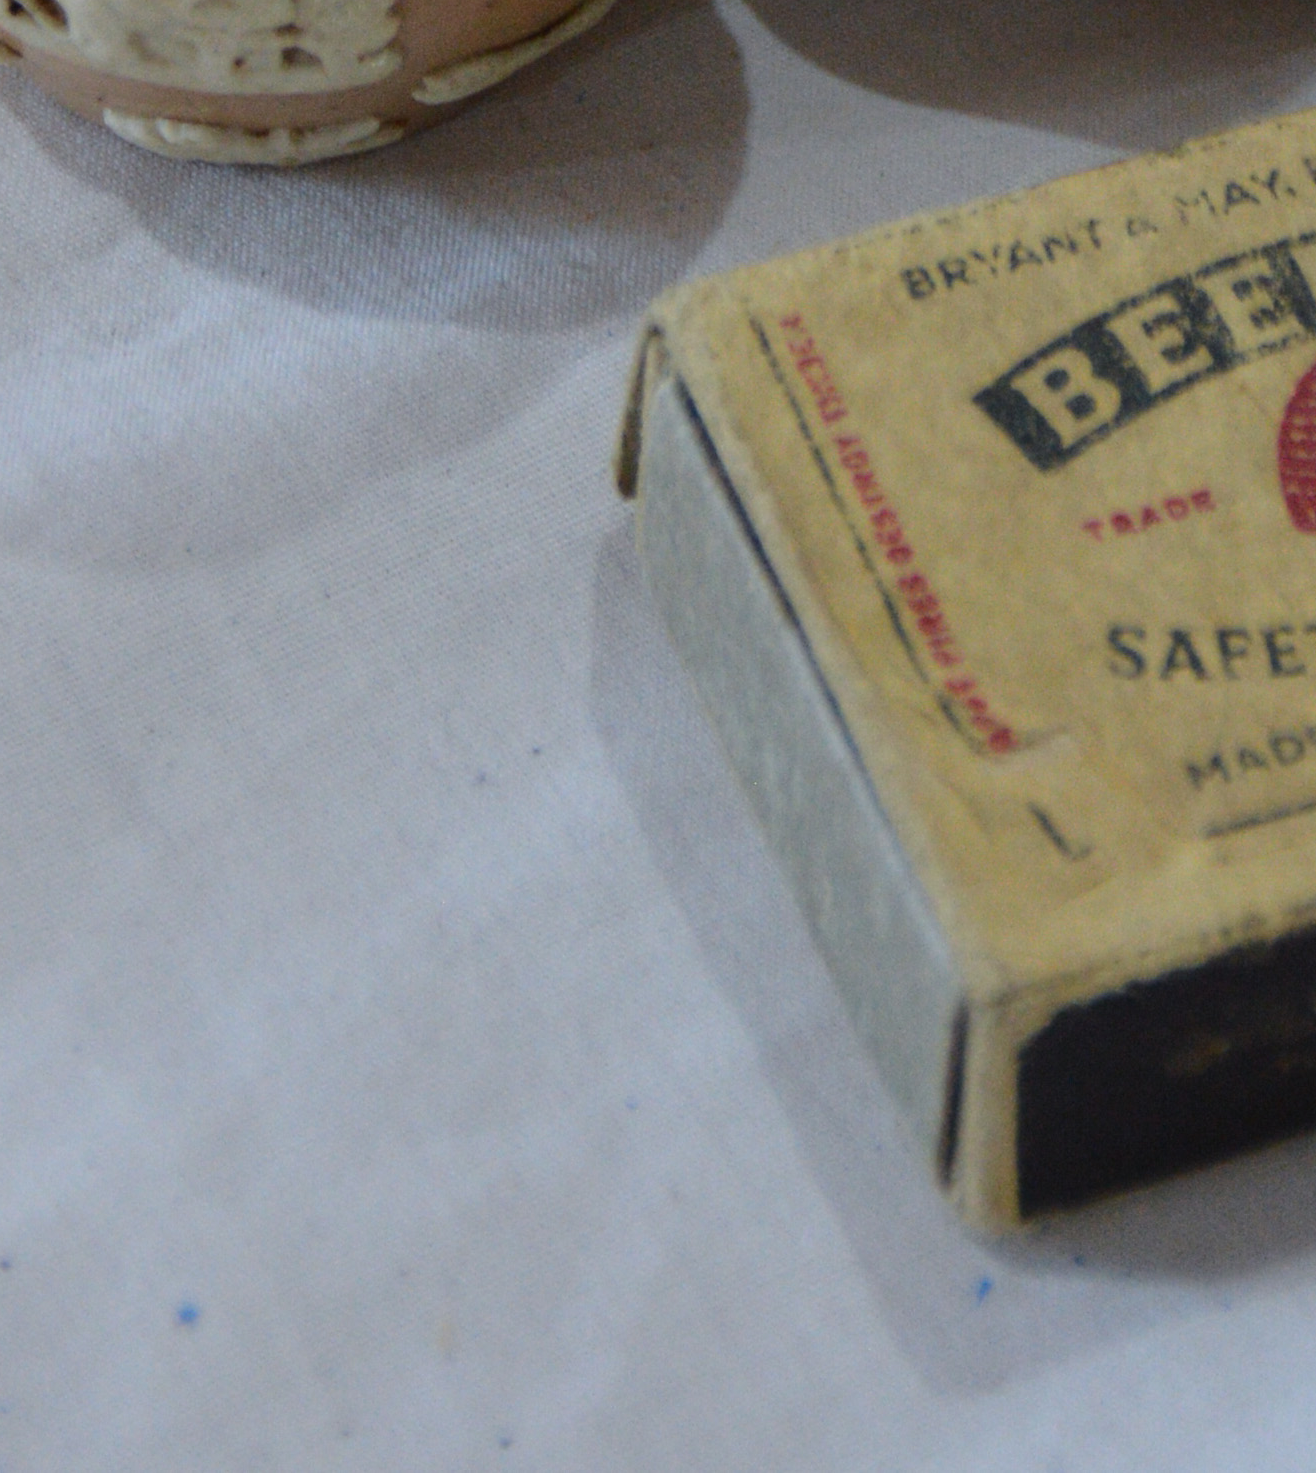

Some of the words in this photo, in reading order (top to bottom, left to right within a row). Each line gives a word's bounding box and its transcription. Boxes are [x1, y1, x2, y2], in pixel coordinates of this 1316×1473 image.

[900, 217, 1102, 301] BRYANT
[833, 433, 915, 567] DESTROY
[1082, 489, 1218, 544] TRADE
